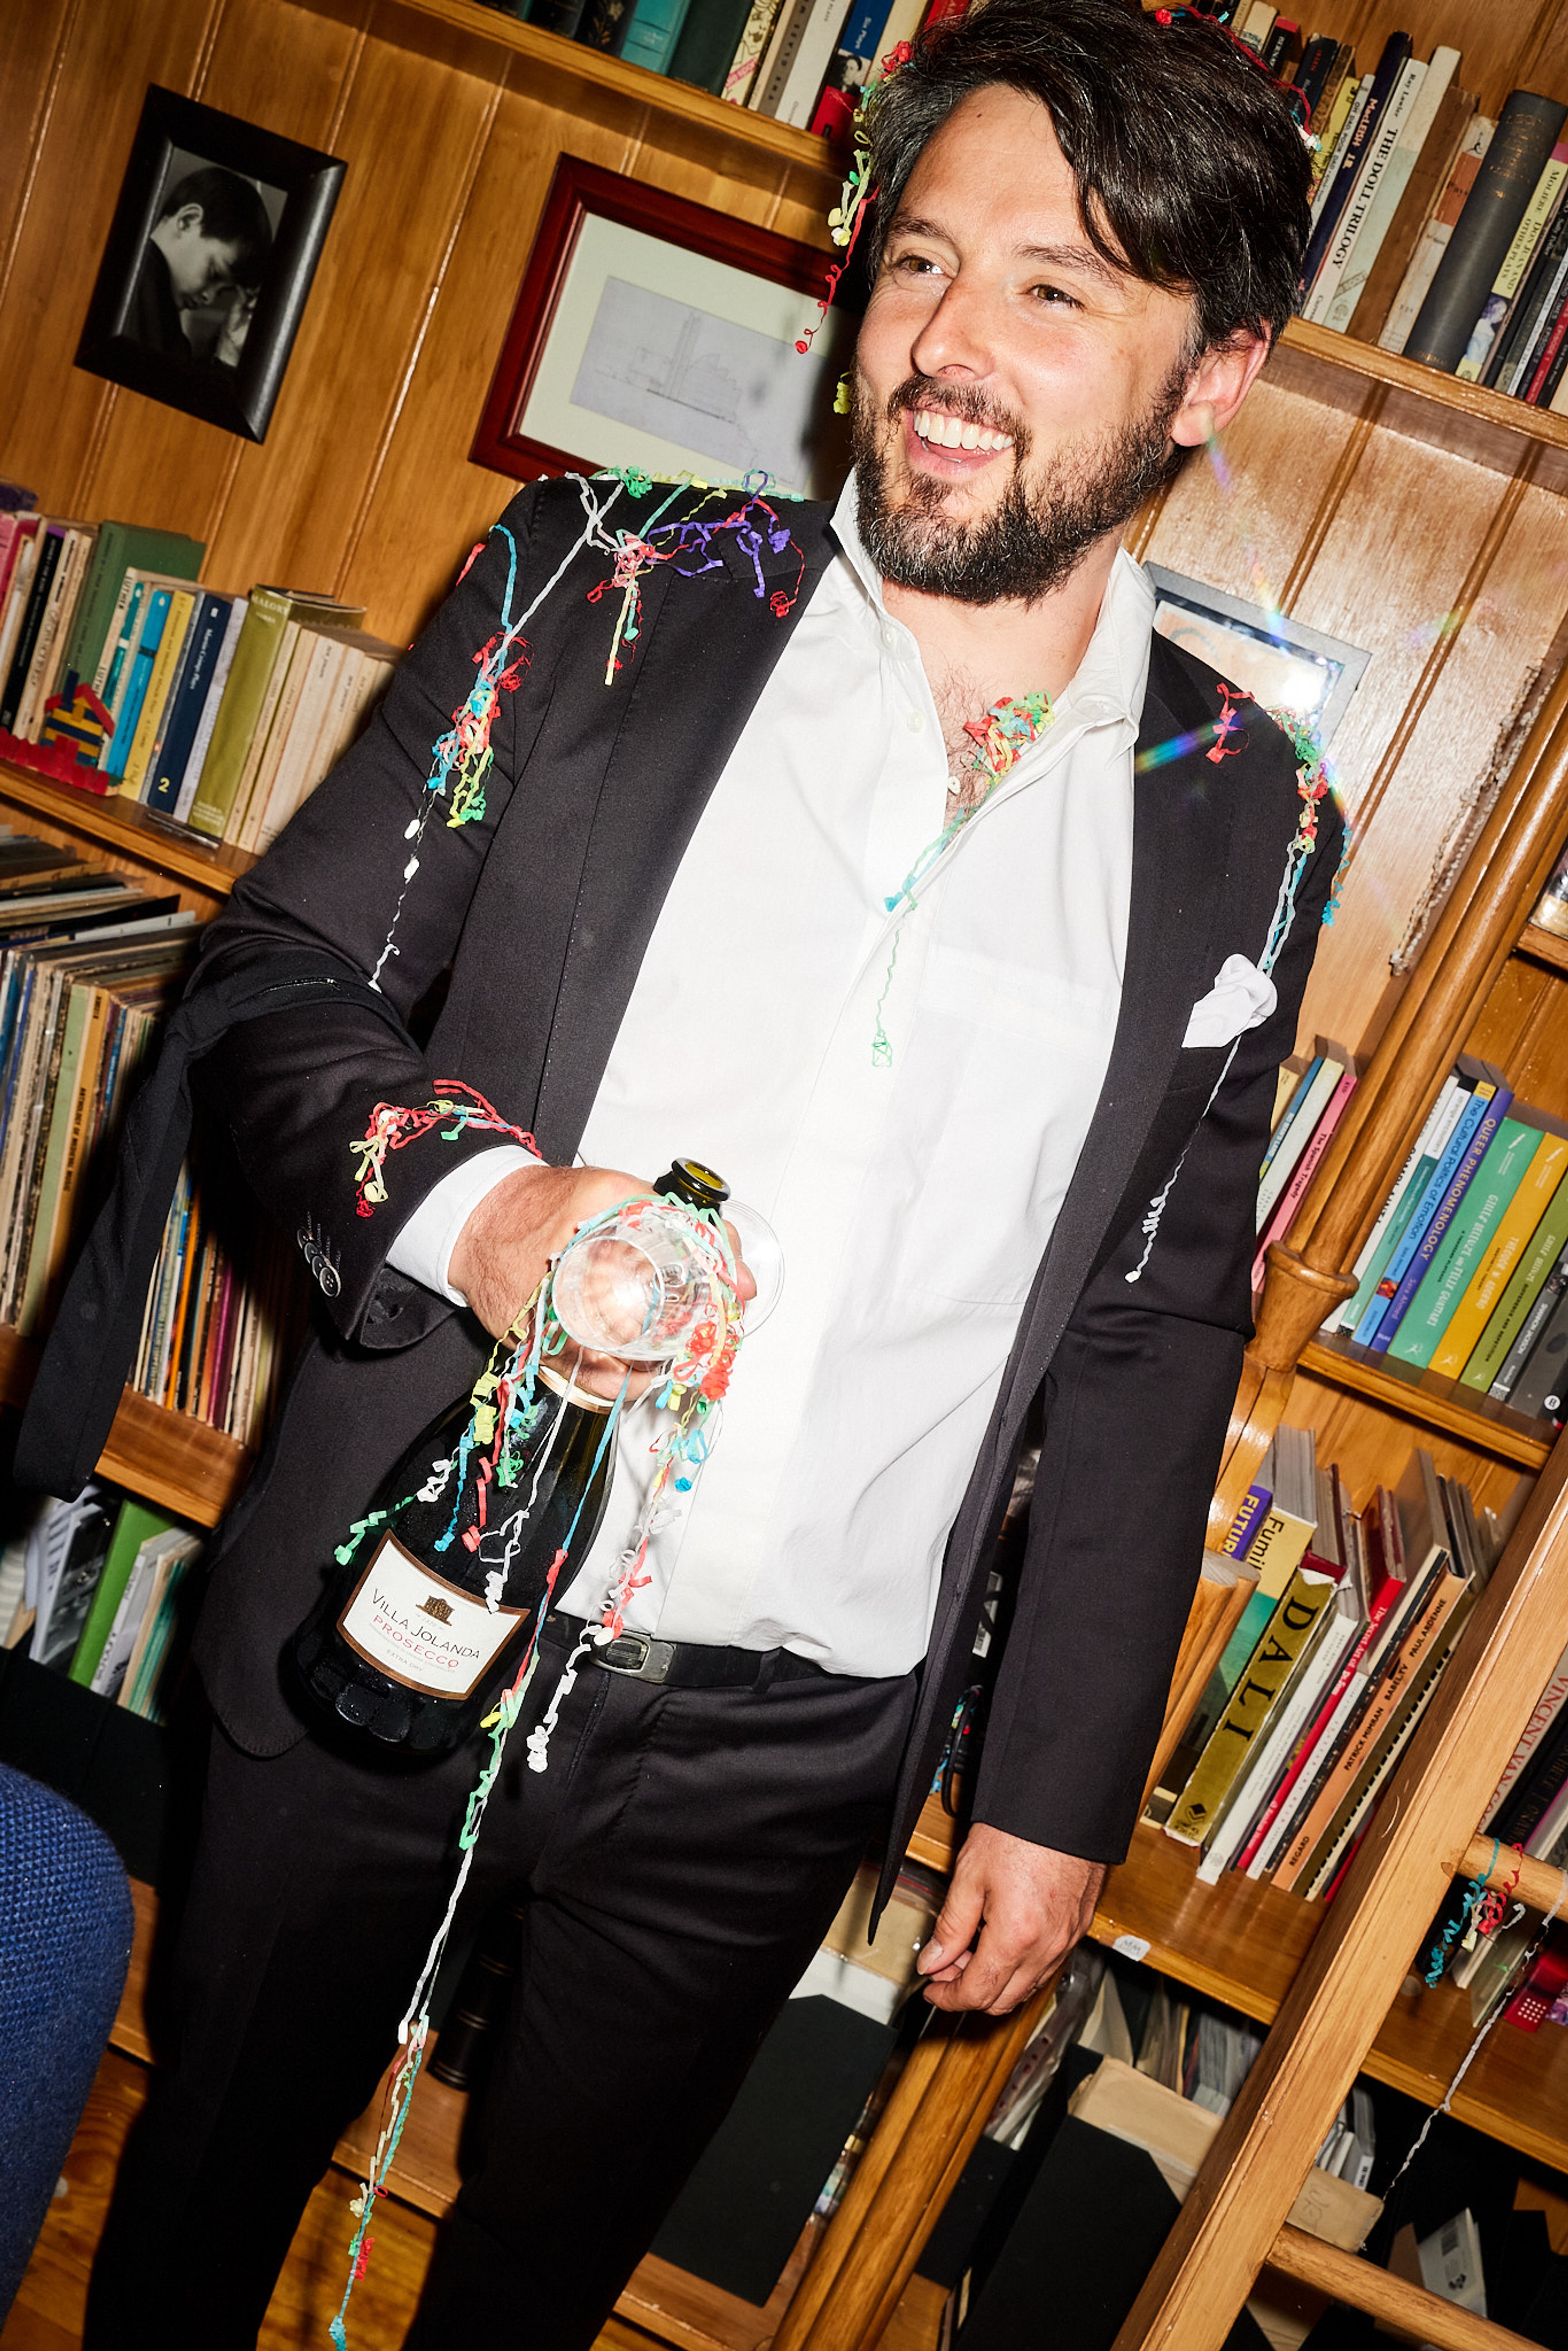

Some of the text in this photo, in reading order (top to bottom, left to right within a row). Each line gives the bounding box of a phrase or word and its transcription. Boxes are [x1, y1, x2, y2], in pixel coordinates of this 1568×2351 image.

[854, 16, 872, 50] Six Plays
[768, 76, 781, 99] THE
[778, 24, 800, 66] GLASS
[1352, 100, 1362, 114] OH
[1334, 133, 1349, 154] POOR
[1327, 154, 1340, 171] DAD
[1333, 74, 1416, 264] Ray Lawler THE DOLL TRILOGY
[1528, 222, 1541, 243] DON
[1551, 216, 1564, 236] Sally
[1502, 218, 1531, 277] OTHER PLAYS
[1516, 245, 1530, 270] JUAN
[1507, 272, 1518, 290] AND
[1551, 276, 1561, 290] AND
[1559, 260, 1567, 275] LIFE
[1544, 291, 1554, 311] TIMES
[1551, 297, 1564, 321] TIMES
[1535, 325, 1552, 358] EPISODE
[1548, 323, 1564, 356] EPISODE
[189, 672, 200, 691] Plays
[157, 776, 171, 793] 2
[1470, 1098, 1484, 1115] The
[62, 1087, 88, 1192] ANTHOLOGY OF MEDIEVAL MUSIC
[1317, 1132, 1326, 1147] The
[1432, 1095, 1464, 1154] strange encounters
[1449, 1114, 1475, 1156] Cultural
[1473, 1116, 1497, 1157] QUEER
[1267, 1142, 1280, 1157] LAND
[1303, 1145, 1319, 1172] Spanish
[1289, 1171, 1307, 1199] Tragedy
[1432, 1155, 1455, 1190] Politics
[1421, 1159, 1475, 1261] PHENOMENOLOGY
[1426, 1188, 1440, 1201] of
[1476, 1192, 1500, 1223] GILLES
[1408, 1201, 1433, 1241] Emotion
[1459, 1221, 1485, 1258] DELEUZE
[1495, 1235, 1519, 1270] THEODOR
[1392, 1279, 1417, 1321] Sara Ahmed
[1425, 1288, 1451, 1327] GUATTARI
[1474, 1278, 1497, 1311] ADORNO
[1508, 1284, 1528, 1318] DIFFERENCE
[1502, 1318, 1512, 1329] AND
[1529, 1301, 1548, 1332] SHANNON
[1485, 1330, 1503, 1362] REPETITION
[1516, 1328, 1535, 1356] JACKSON
[372, 1588, 480, 1659] VILLA JOLANDA
[1374, 1604, 1388, 1622] The
[1408, 1598, 1448, 1658] PAUL ARDENNE
[373, 1615, 459, 1668] PROSECCO
[1360, 1620, 1377, 1646] Secret
[387, 1649, 408, 1665] EXTRA
[1347, 1657, 1358, 1668] of
[1352, 1644, 1365, 1660] Art
[1218, 1599, 1321, 1738] DALI
[1518, 1678, 1568, 1745] VINCENT
[1342, 1738, 1367, 1772] PATRICK
[1361, 1706, 1385, 1739] MIMRAN
[1256, 1807, 1274, 1833] Random
[1246, 1830, 1261, 1850] House
[1287, 1834, 1312, 1867] REGARD
